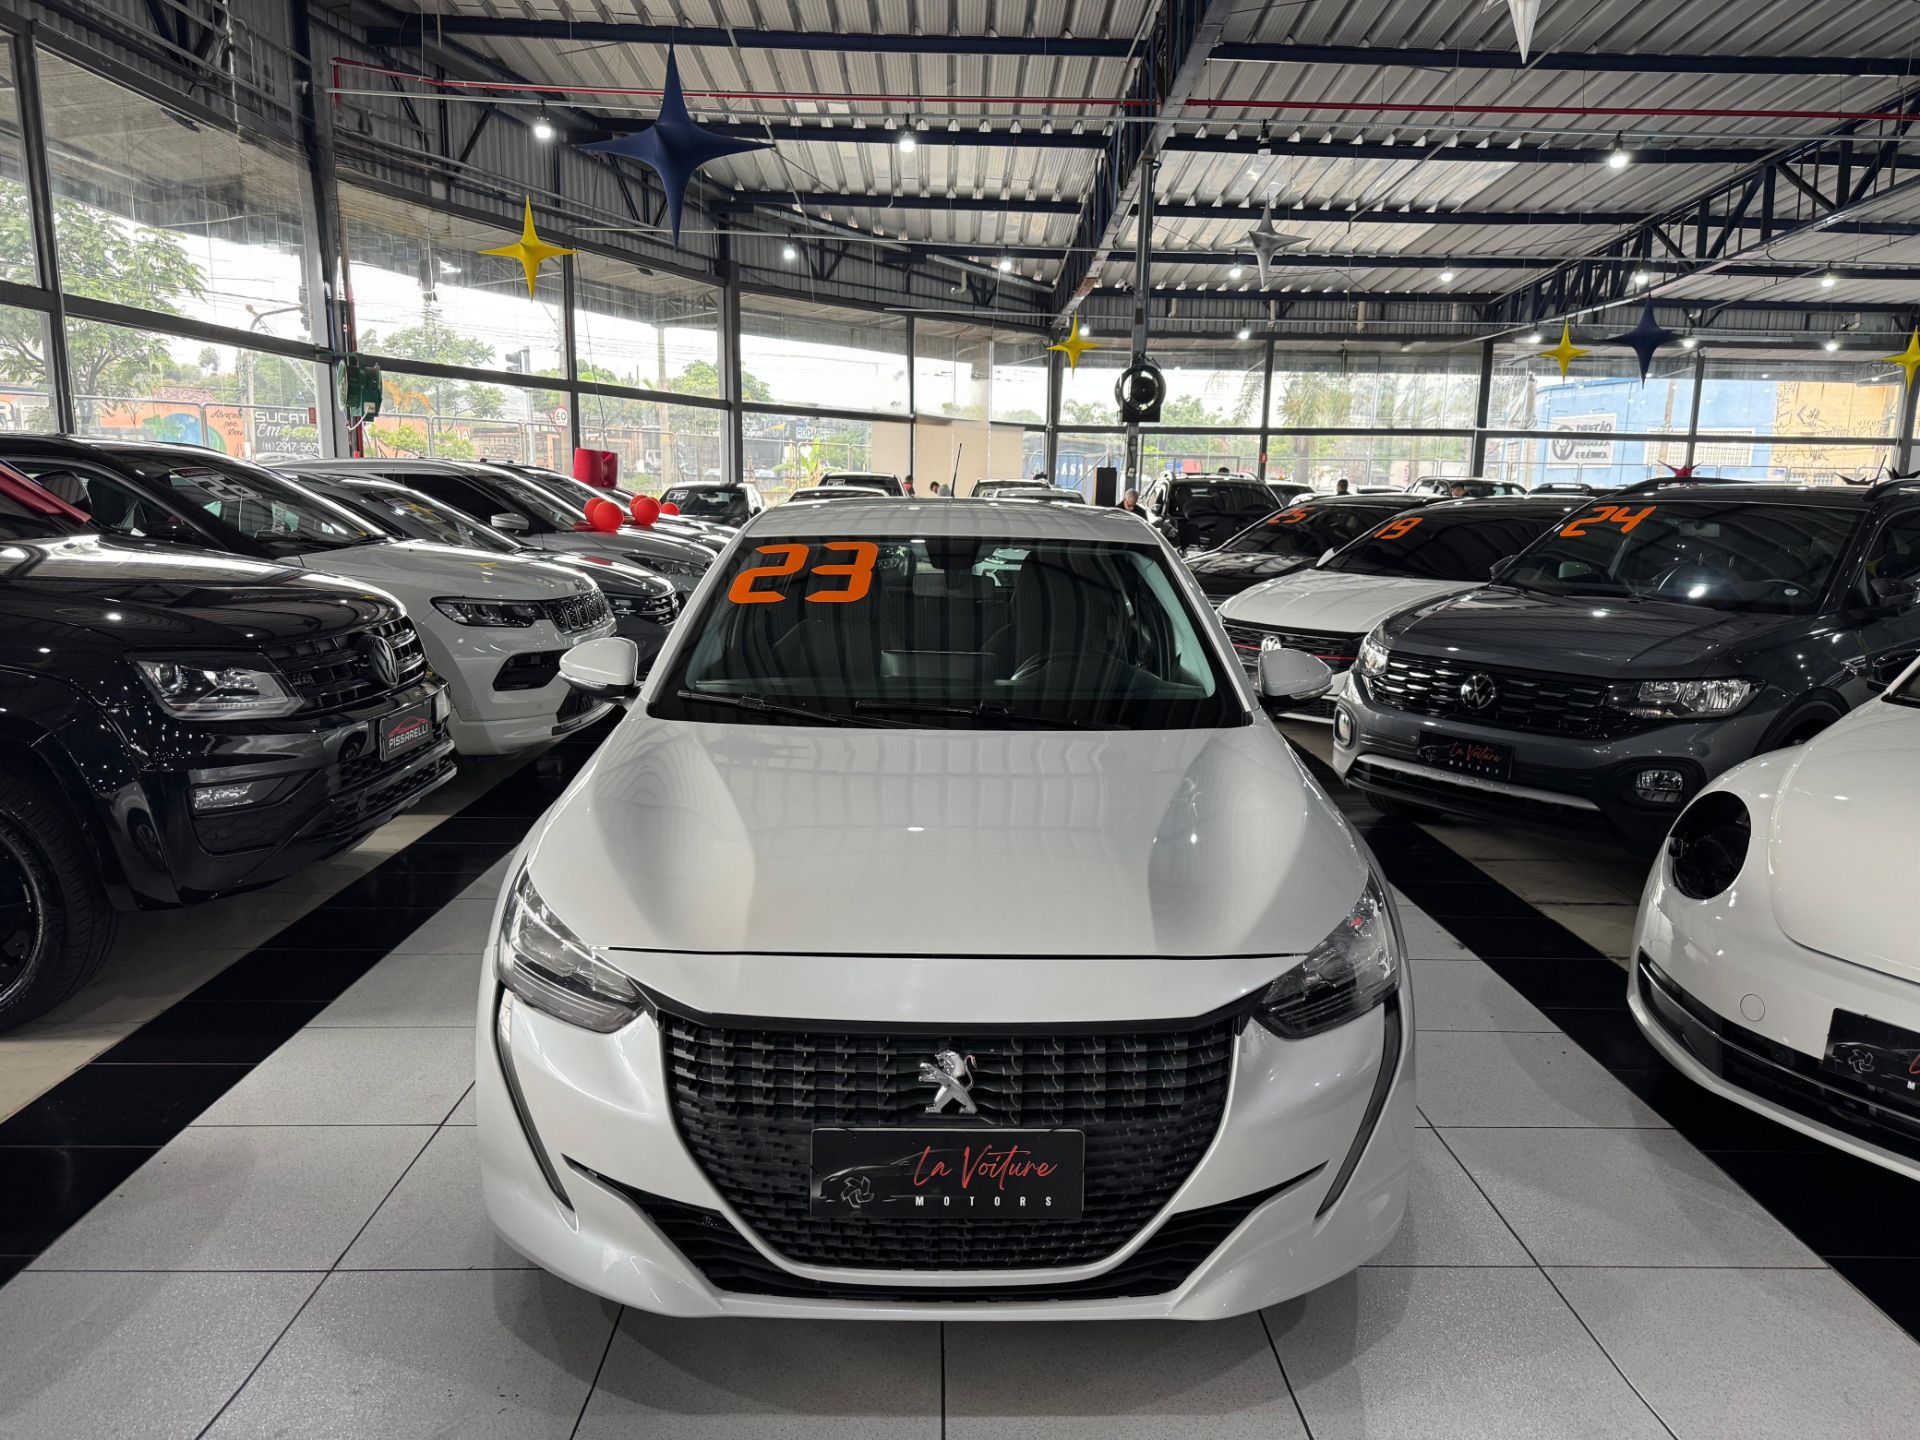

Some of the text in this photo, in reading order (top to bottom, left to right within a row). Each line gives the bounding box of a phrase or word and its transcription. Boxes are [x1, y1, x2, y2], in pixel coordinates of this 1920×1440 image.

[254, 411, 310, 424] SUCAT
[256, 423, 281, 437] Em
[1374, 517, 1424, 540] 19
[1560, 506, 1656, 537] 24
[728, 541, 878, 604] 23
[388, 723, 429, 749] PISSARELLI
[913, 1144, 1058, 1191] La Voiture
[915, 1196, 1052, 1207] MOTORS
